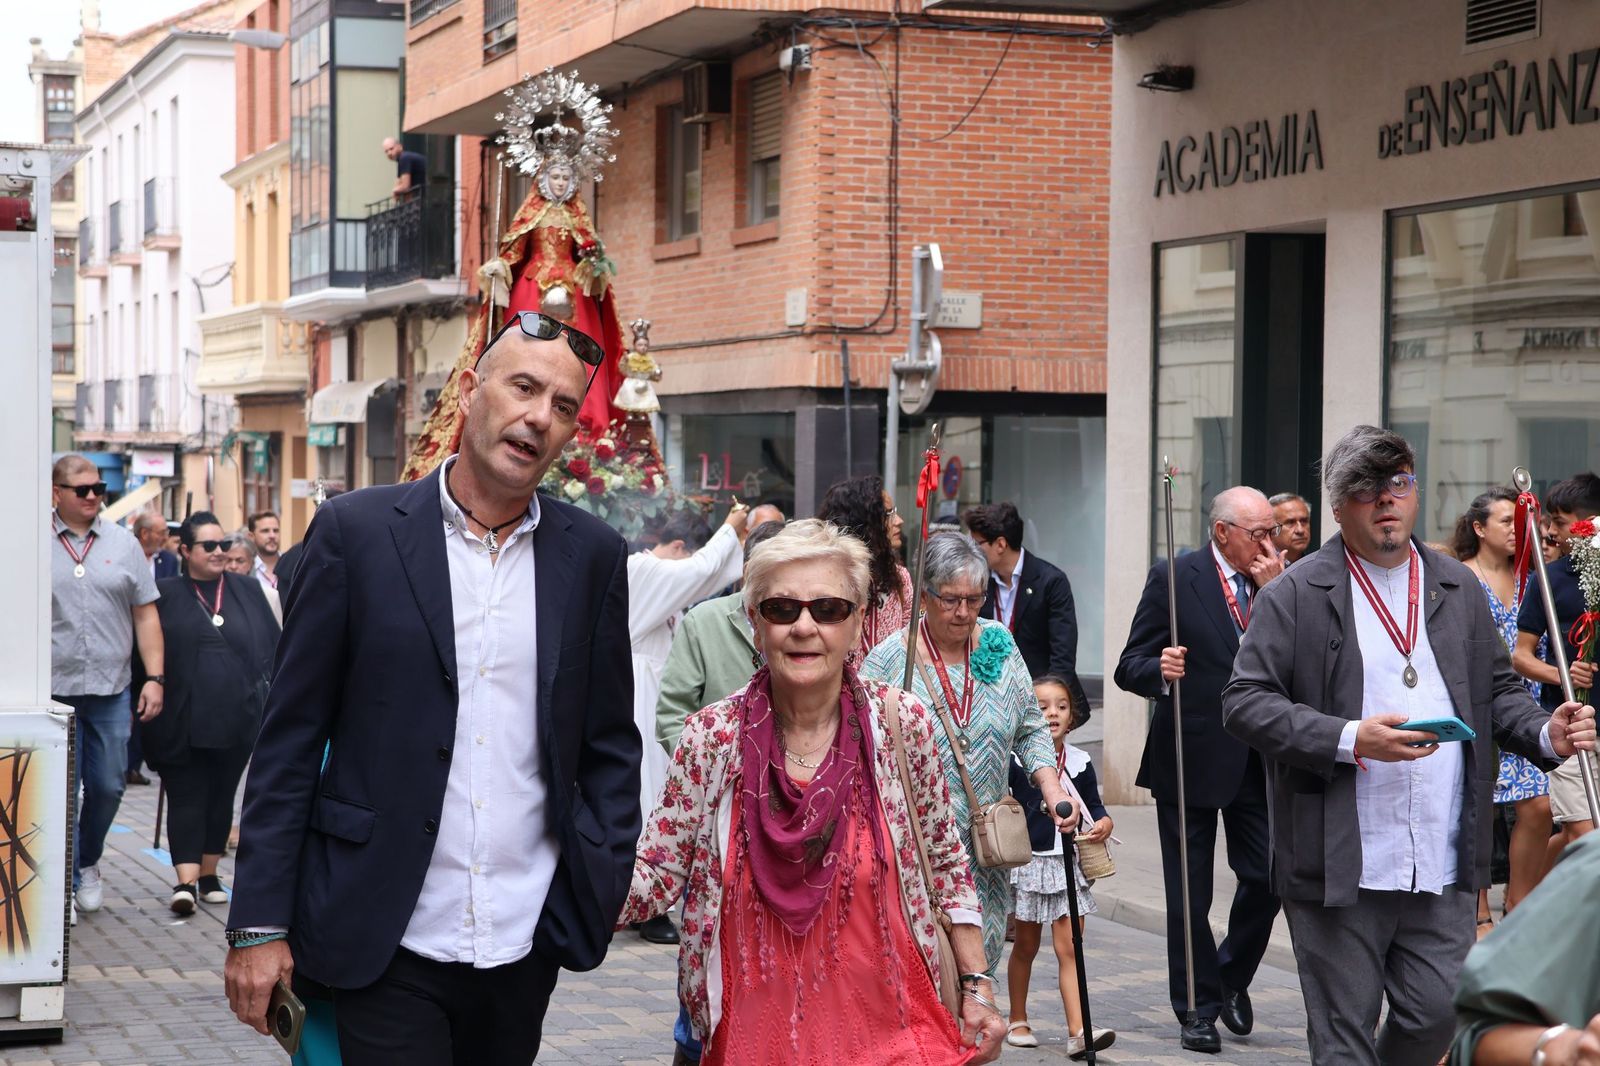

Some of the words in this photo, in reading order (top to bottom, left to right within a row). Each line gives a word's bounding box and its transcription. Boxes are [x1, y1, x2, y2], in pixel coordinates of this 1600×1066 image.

[1153, 109, 1324, 198] ACADEMIA
[1377, 121, 1403, 160] DE
[1404, 47, 1600, 155] ENSEÑANZ
